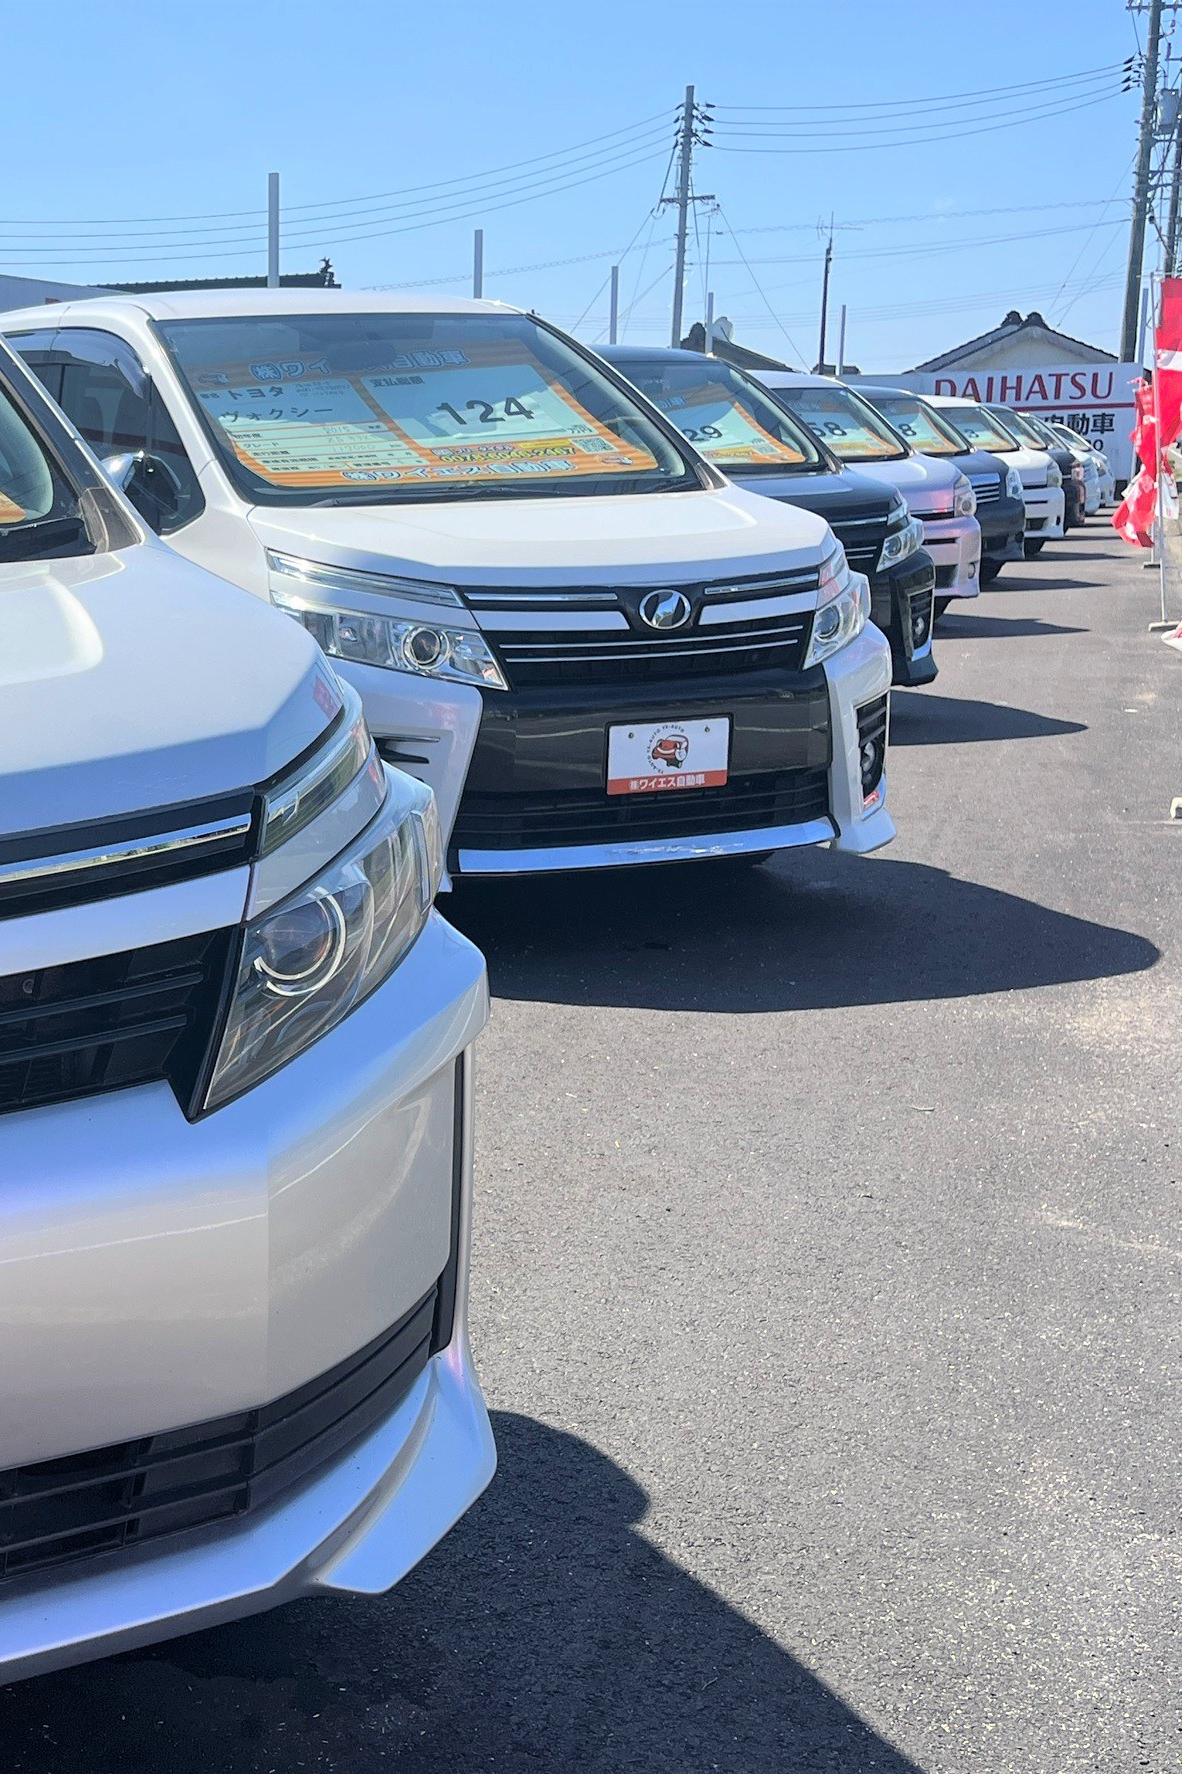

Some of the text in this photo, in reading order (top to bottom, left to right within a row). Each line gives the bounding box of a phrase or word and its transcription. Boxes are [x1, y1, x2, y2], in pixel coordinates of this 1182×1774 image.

[227, 385, 285, 400] トヨタ
[934, 371, 1114, 402] DAIHATSU
[221, 406, 333, 422] ヴォクシー
[436, 396, 534, 425] 124
